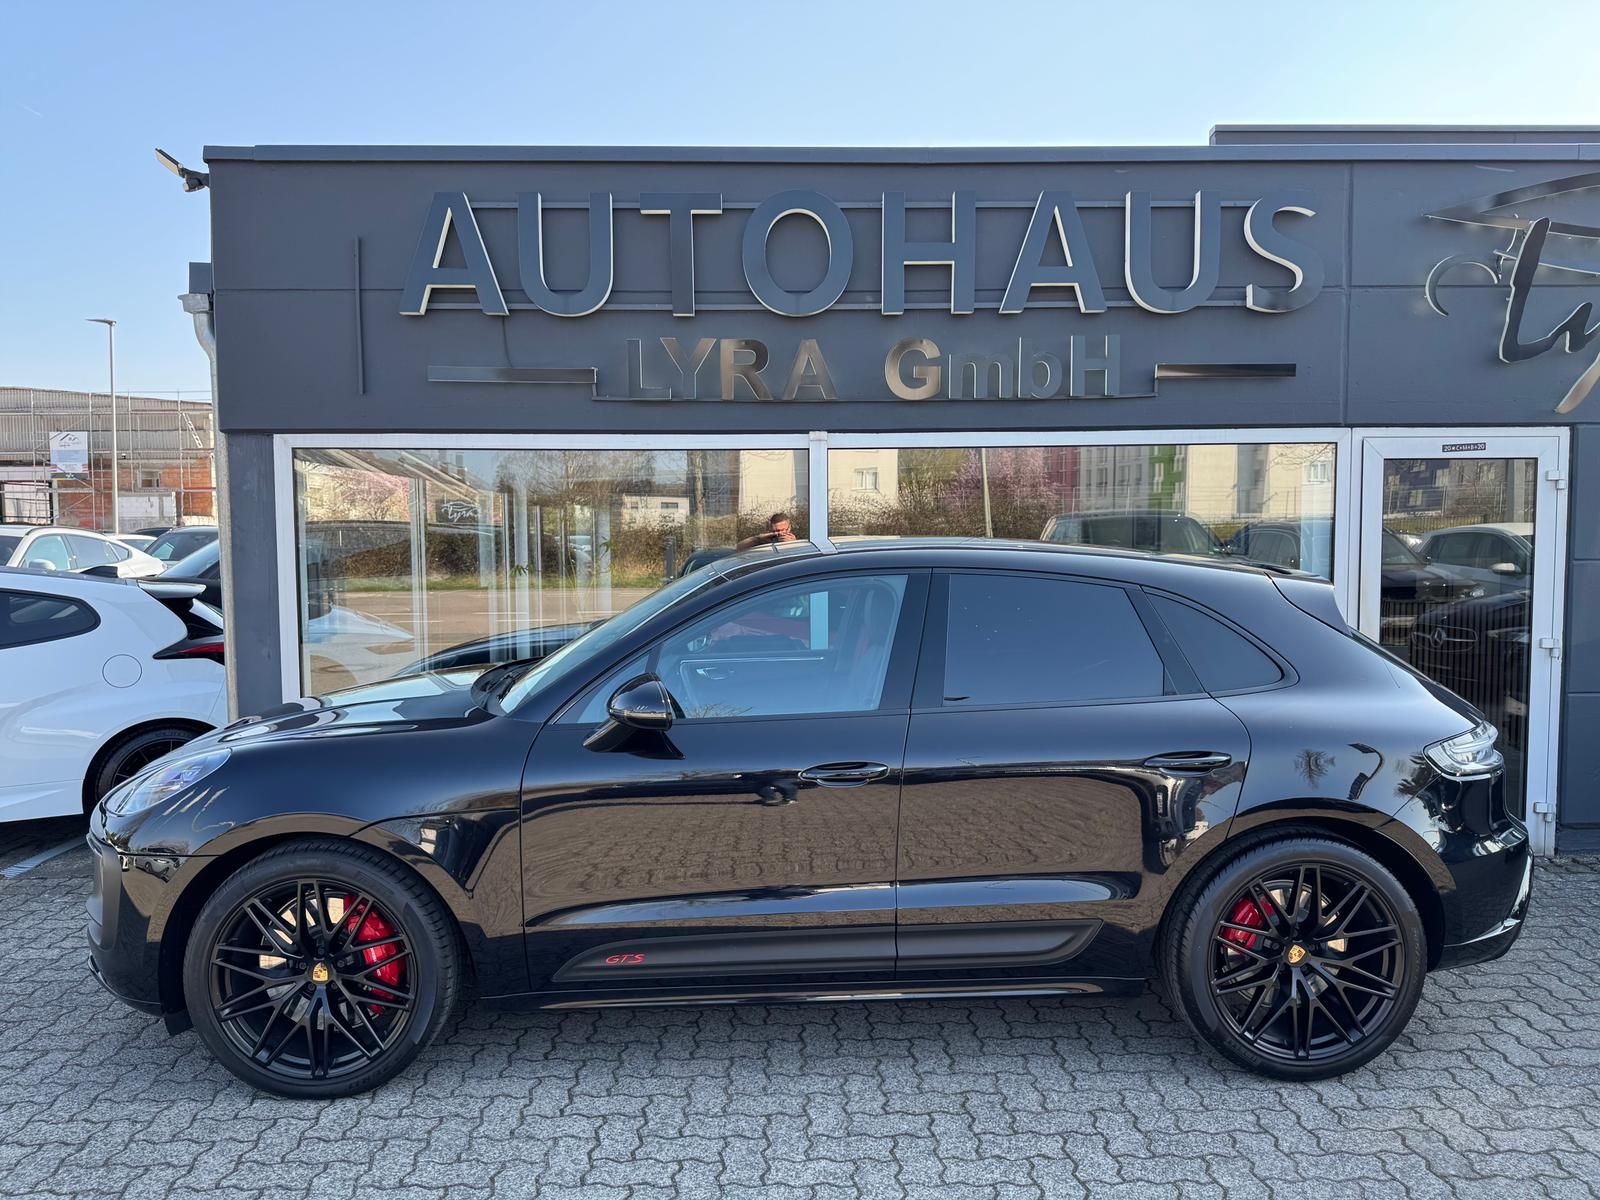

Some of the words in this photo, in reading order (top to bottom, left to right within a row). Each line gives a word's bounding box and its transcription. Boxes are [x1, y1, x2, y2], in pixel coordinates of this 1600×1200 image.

[399, 190, 1325, 317] AUTOHAUS
[625, 337, 838, 401] LYRA
[883, 333, 1121, 401] GmbH
[605, 953, 645, 965] GTS
